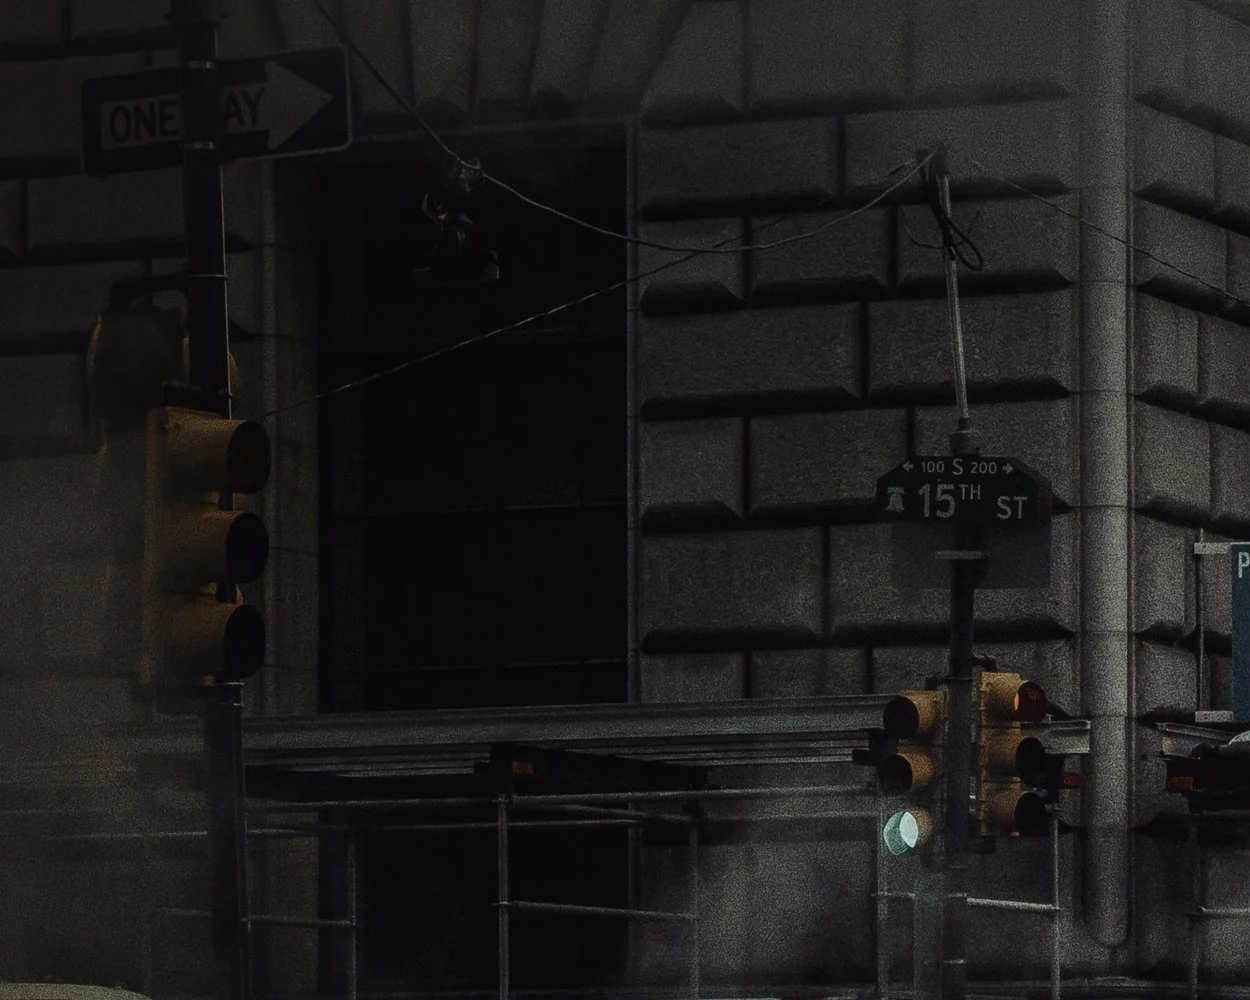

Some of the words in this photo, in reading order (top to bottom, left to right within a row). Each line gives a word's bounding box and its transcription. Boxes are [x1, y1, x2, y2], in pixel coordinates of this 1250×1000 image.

[109, 101, 179, 144] ONE
[223, 86, 265, 129] AY
[920, 461, 945, 473] 100
[952, 458, 964, 476] S
[970, 461, 997, 474] 200
[918, 483, 982, 519] 15TH
[996, 496, 1029, 520] ST
